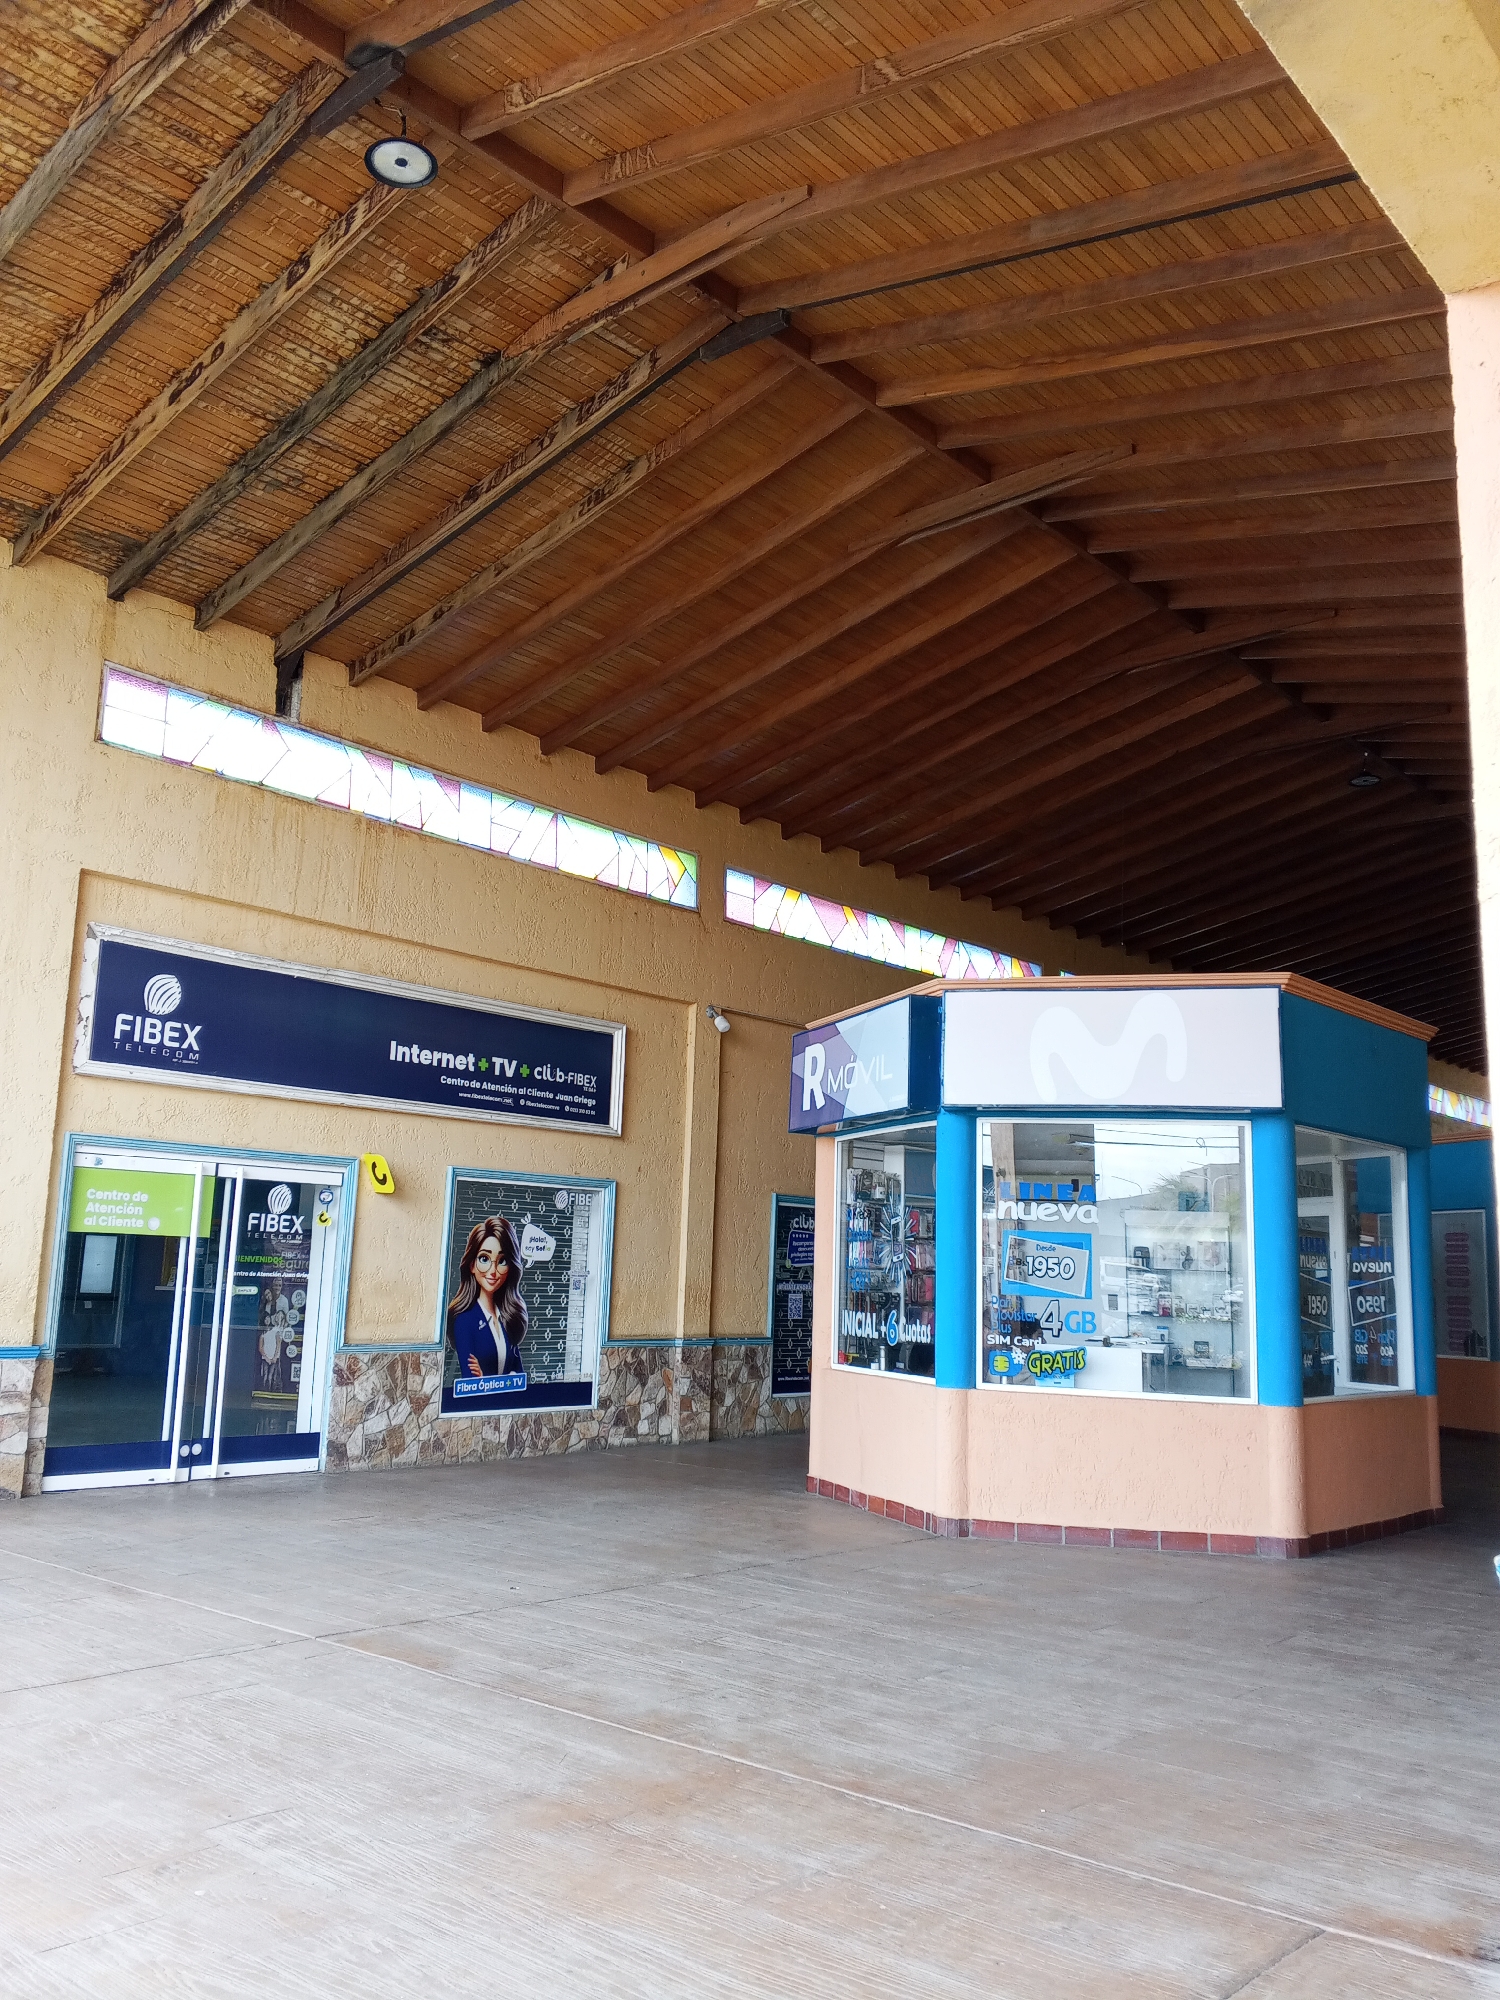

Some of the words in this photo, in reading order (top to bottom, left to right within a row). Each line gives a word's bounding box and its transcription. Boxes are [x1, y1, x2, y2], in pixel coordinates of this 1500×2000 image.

[114, 1013, 202, 1051] FIBEX
[113, 1041, 199, 1060] TELECOM
[389, 1040, 475, 1072] Internet
[492, 1056, 518, 1078] TV
[803, 1043, 826, 1111] R
[827, 1054, 893, 1094] MÓVIL
[440, 1075, 470, 1088] Centro
[470, 1079, 480, 1089] de
[482, 1082, 518, 1095] Atención
[519, 1086, 526, 1095] al
[527, 1088, 553, 1099] Cliente
[555, 1093, 573, 1102] Juan
[574, 1095, 597, 1106] Griego
[86, 1188, 130, 1201] Centro
[132, 1191, 148, 1202] de
[569, 1193, 592, 1206] FIBE
[1000, 1182, 1096, 1202] LINEA
[85, 1202, 143, 1215] Atención
[998, 1200, 1099, 1223] nueva
[83, 1215, 96, 1226] al
[98, 1216, 144, 1228] Cliente
[247, 1212, 305, 1234] FIBEX
[247, 1232, 303, 1240] TELECOM
[1036, 1244, 1056, 1252] Desde
[236, 1255, 283, 1263] IENVENIDOS
[1026, 1256, 1075, 1280] 1950
[991, 1309, 1037, 1322] Movistar
[1040, 1299, 1063, 1338] 4
[1064, 1311, 1097, 1334] GB
[842, 1309, 878, 1339] INICIAL
[886, 1309, 899, 1346] 6
[900, 1316, 931, 1344] Cuotas
[987, 1334, 1011, 1345] SIM
[1013, 1336, 1042, 1347] Card
[1028, 1347, 1086, 1377] GRATIS
[457, 1382, 477, 1393] Fibra
[478, 1378, 504, 1393] Óptica
[513, 1377, 523, 1387] TV
